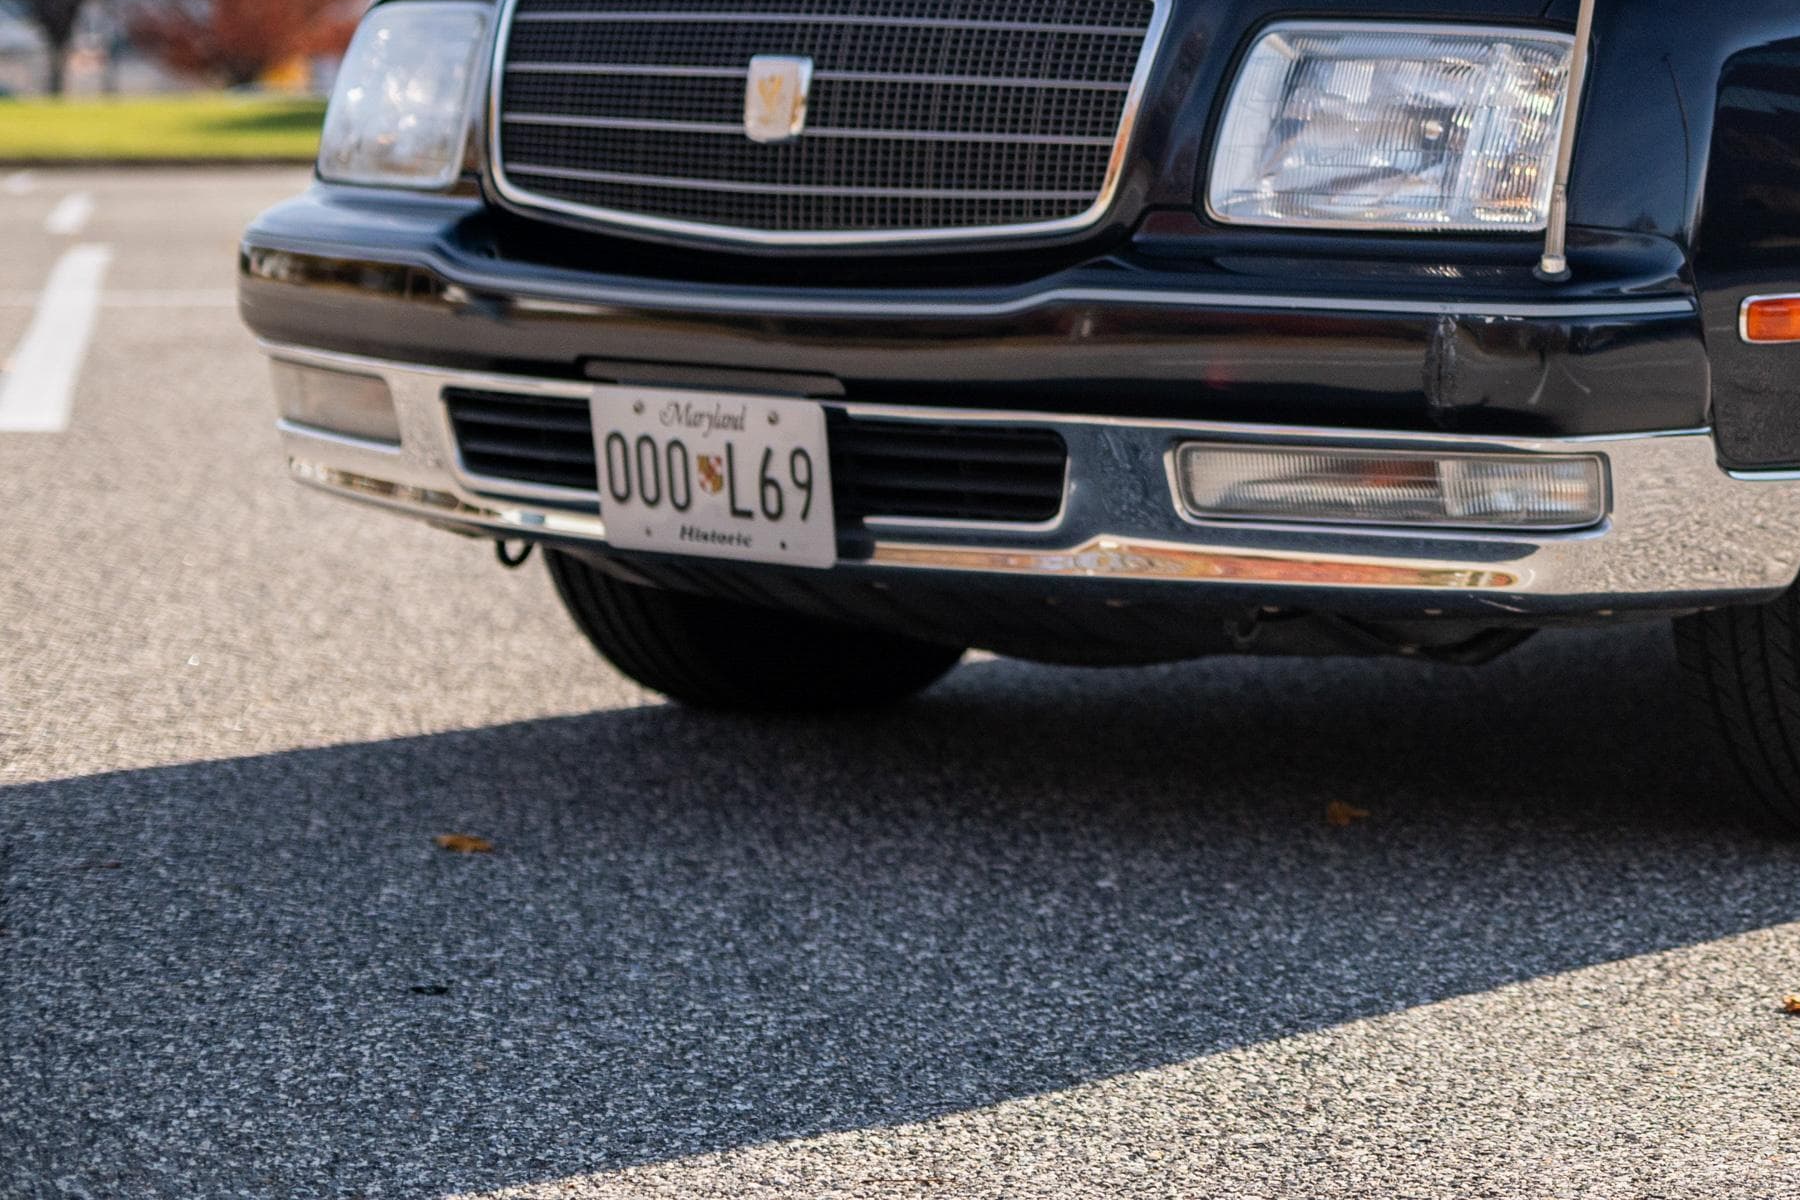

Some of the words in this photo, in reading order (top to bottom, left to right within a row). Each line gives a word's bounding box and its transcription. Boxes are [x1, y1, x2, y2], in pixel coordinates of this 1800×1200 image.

[658, 401, 747, 438] Maryland
[725, 441, 813, 522] L69
[679, 525, 753, 548] Historic
